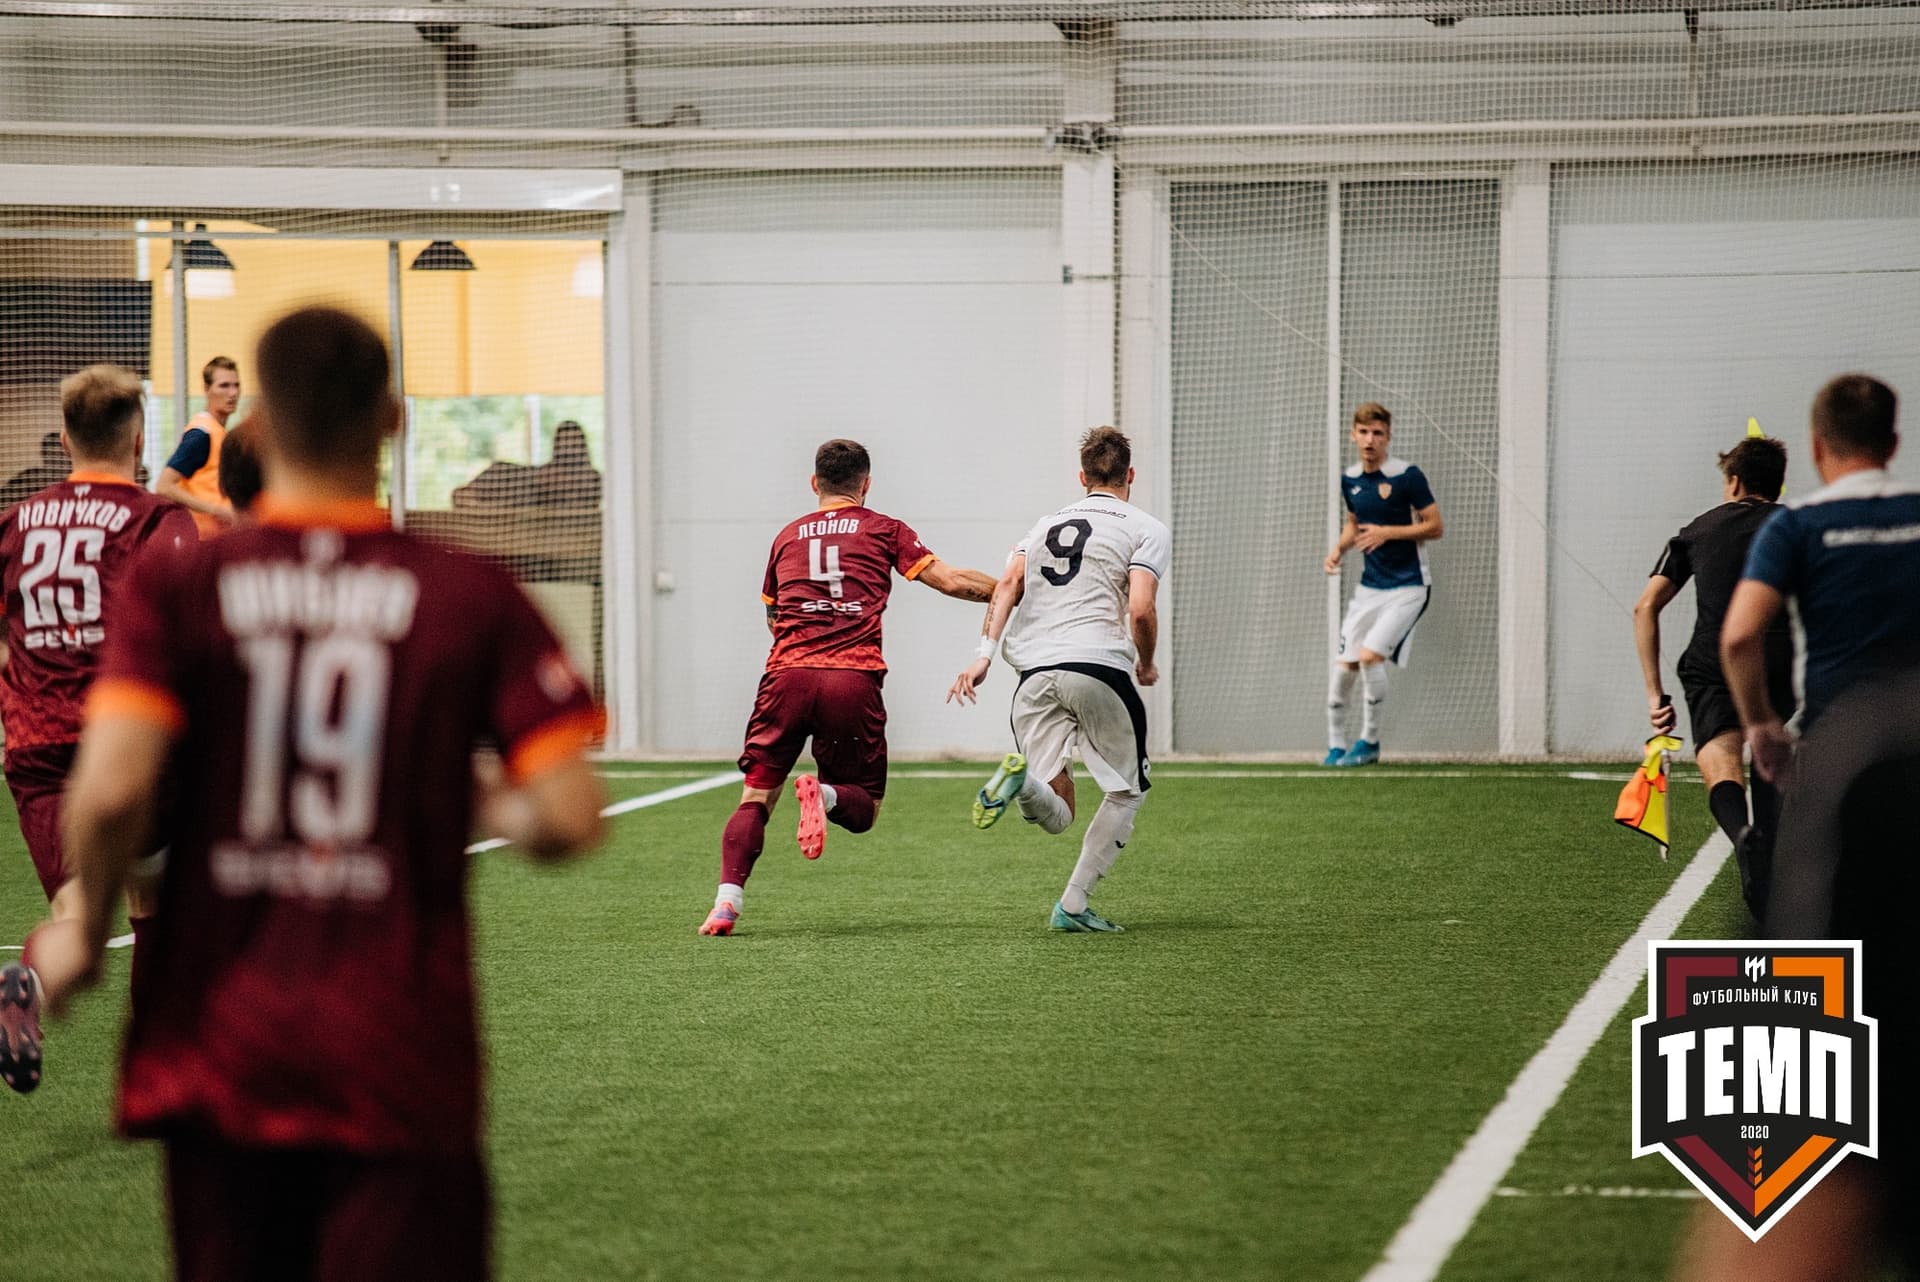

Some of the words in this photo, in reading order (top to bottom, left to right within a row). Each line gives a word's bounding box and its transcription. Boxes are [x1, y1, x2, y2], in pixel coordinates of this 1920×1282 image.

[18, 499, 132, 533] НОВИЧКОВ
[797, 518, 860, 540] ЛЕОНОВ
[19, 527, 106, 629] 25
[808, 538, 845, 598] 4
[1041, 518, 1093, 586] 9
[236, 637, 394, 842] 19
